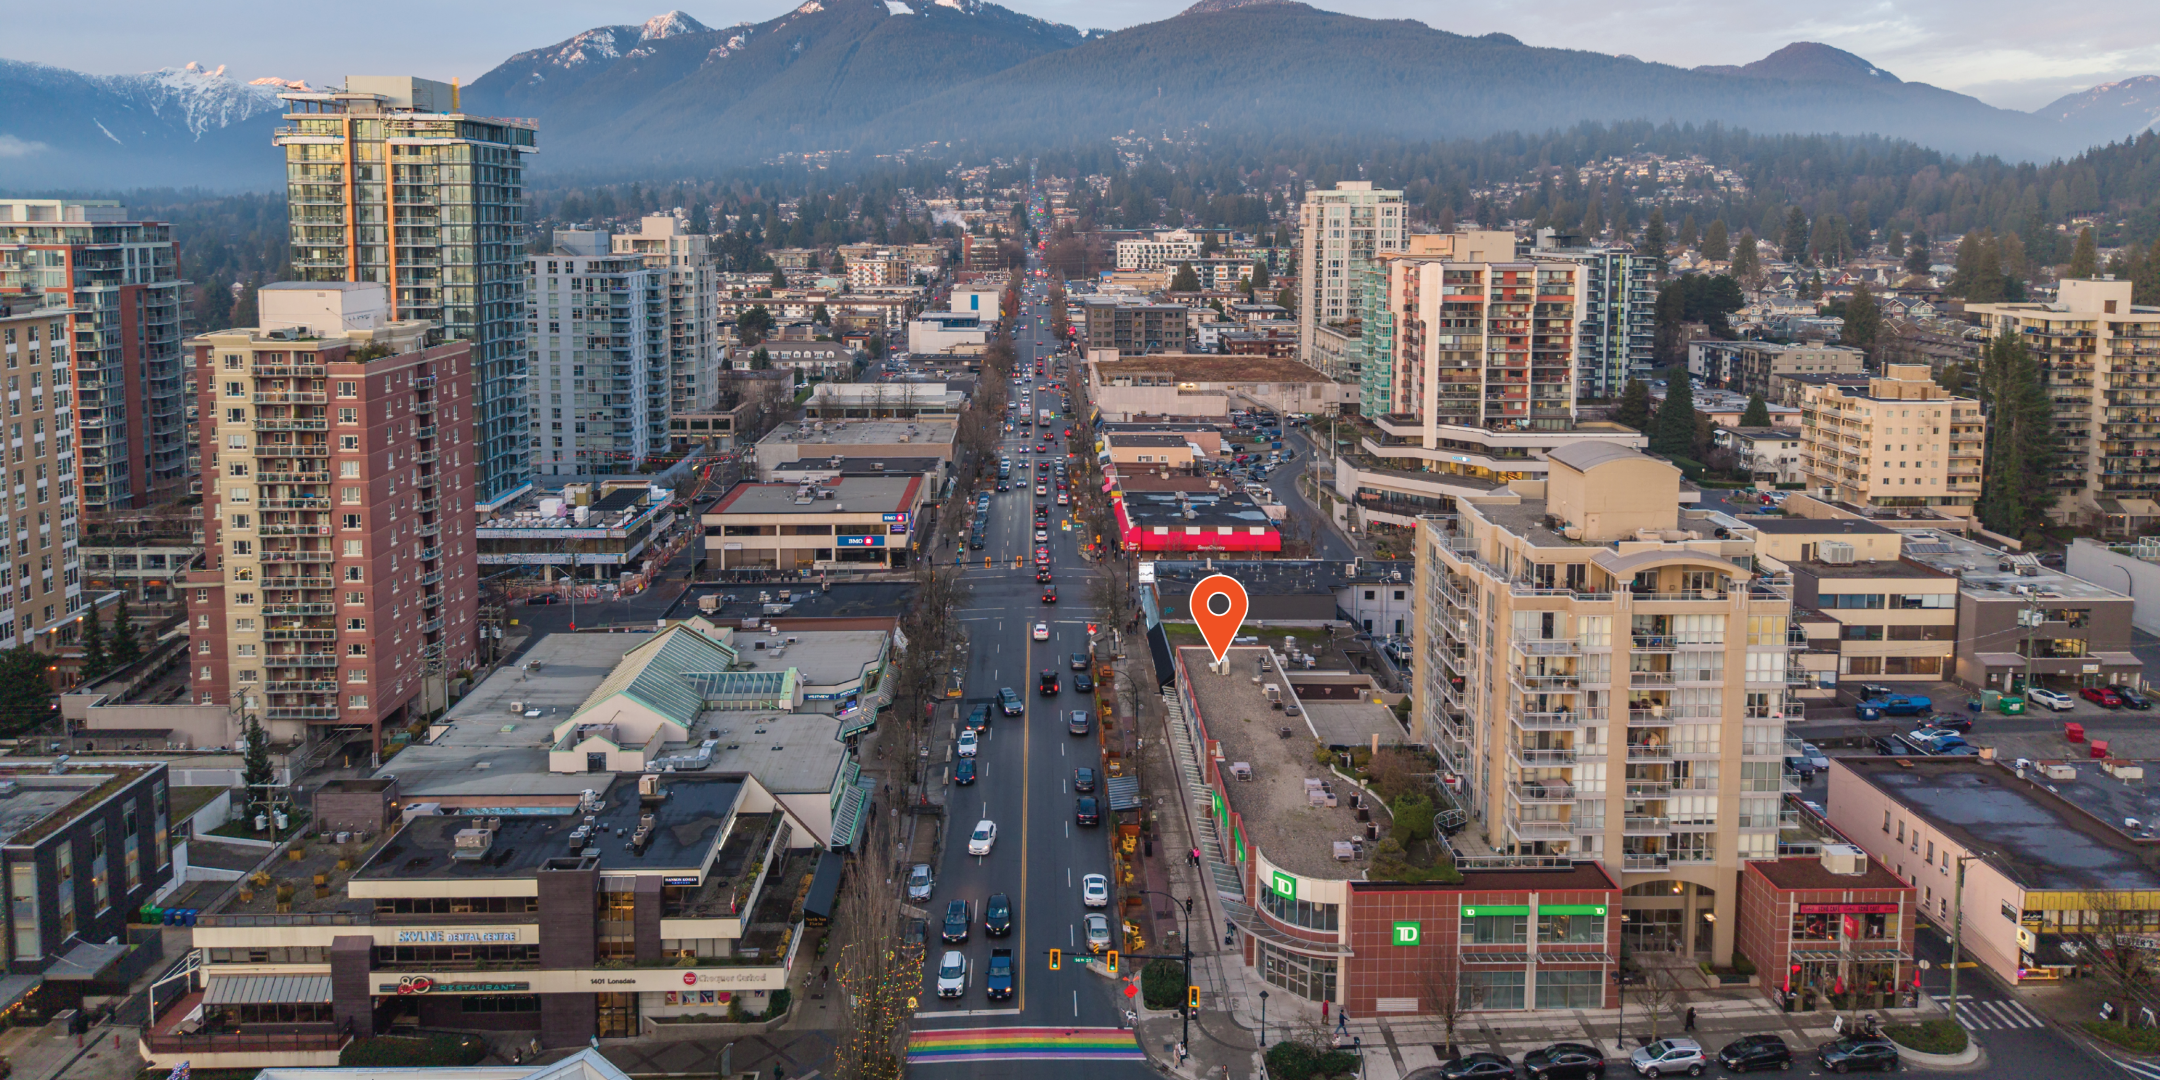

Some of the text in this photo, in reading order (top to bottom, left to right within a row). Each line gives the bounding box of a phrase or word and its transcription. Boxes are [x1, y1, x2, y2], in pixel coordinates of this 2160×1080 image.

[1274, 876, 1293, 895] TD
[1595, 907, 1605, 915] TD
[398, 930, 516, 942] SKYLINE DENTAL CENTRE
[1396, 926, 1418, 942] TD
[440, 983, 516, 991] RESTAURANT
